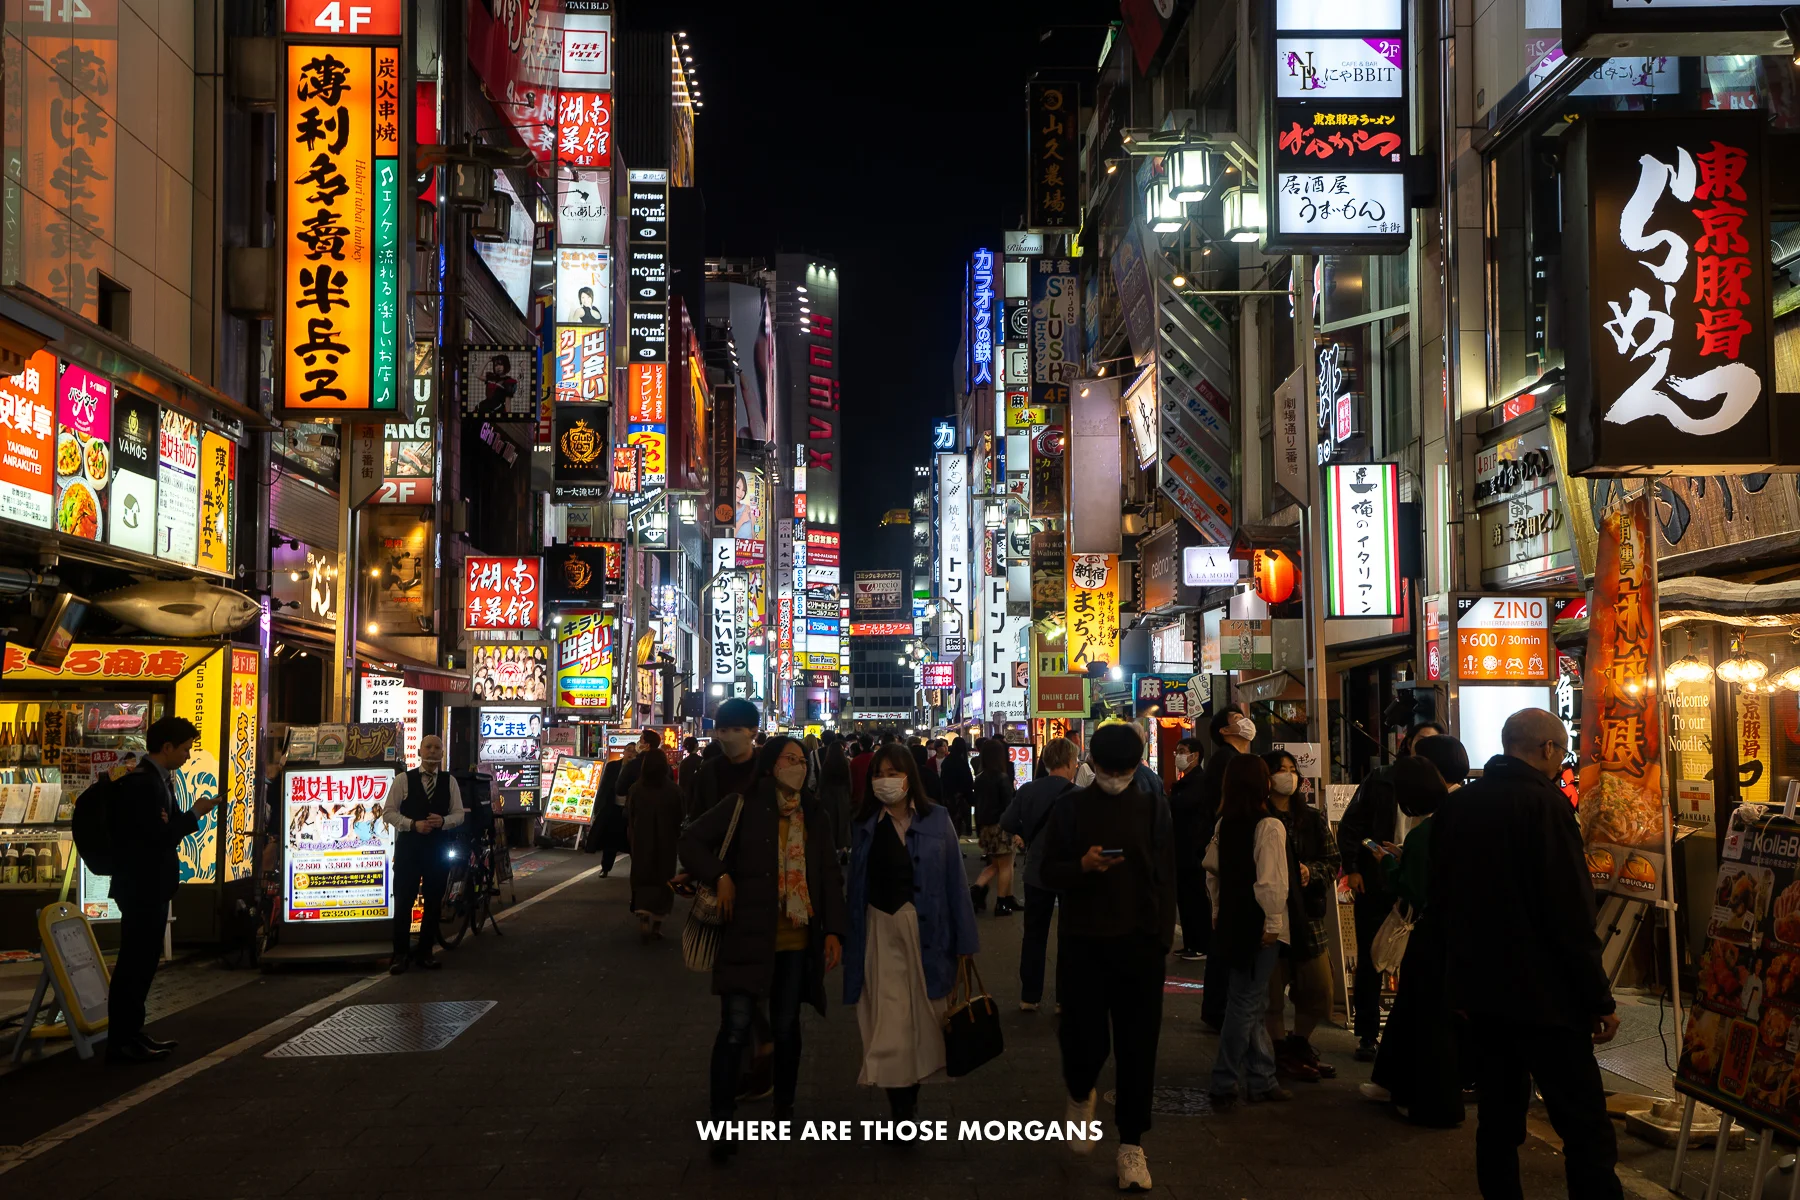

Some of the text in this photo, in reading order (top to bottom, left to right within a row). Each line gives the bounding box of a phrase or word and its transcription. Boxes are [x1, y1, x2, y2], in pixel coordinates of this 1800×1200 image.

[315, 1, 373, 33] 4F
[565, 1, 609, 10] TAKI BLD
[1379, 41, 1400, 57] 2F
[376, 58, 398, 143] 炭火串焼
[559, 95, 610, 126] 湖南
[1313, 112, 1396, 126] 東京豚骨ラーメン
[559, 126, 610, 156] 菜館
[575, 155, 594, 165] 4F
[355, 159, 367, 198] Hakuri
[1281, 175, 1350, 196] 居酒屋
[1367, 222, 1402, 233] 一番街
[1691, 140, 1753, 359] 東京豚骨
[1039, 259, 1071, 274] 麻雀
[634, 312, 663, 320] Party Space
[973, 247, 995, 385] カラオケの鉄人
[560, 330, 576, 380] カフェ
[583, 331, 606, 400] 出会い
[557, 381, 579, 389] キラリ
[641, 365, 653, 422] リフレッシュ
[1044, 388, 1068, 402] 4F
[1032, 425, 1043, 433] 3F
[1283, 397, 1298, 476] 劇場通り一番街
[7, 440, 39, 460] YAKINIKU
[2, 453, 42, 476] ANRAKUTEI
[379, 481, 417, 504] 2F
[1041, 458, 1052, 509] カリーナ
[948, 504, 960, 552] 焼とん酒場
[1351, 498, 1374, 614] 俺のイタリアン
[470, 558, 536, 596] 湖南
[1075, 561, 1106, 581] 新宿
[468, 597, 482, 627] 4F
[482, 596, 536, 628] 菜館
[715, 546, 734, 675] とんかつにいむら
[1458, 599, 1472, 608] 5F
[1494, 601, 1544, 620] ZINO
[1555, 601, 1566, 609] 4F
[563, 612, 605, 636] キラリ
[1073, 591, 1098, 664] まっちゃん
[560, 625, 609, 665] 出会い
[735, 626, 747, 670] ちから
[991, 581, 1006, 694] トントン
[1507, 635, 1541, 646] 30min
[3, 647, 188, 676] まろ商店
[232, 655, 257, 673] 地下1階
[579, 650, 611, 674] カフェ
[924, 665, 952, 675] 24時間
[196, 661, 207, 690] Tuna
[925, 675, 952, 685] 営業中
[1164, 680, 1187, 688] フリー
[1041, 693, 1080, 701] ONLINE CAFE
[1666, 691, 1709, 708] Welcome
[481, 722, 527, 736] りこまき
[1672, 714, 1706, 731] To our
[44, 710, 64, 764] 営業中
[347, 725, 396, 756] オープン
[1668, 735, 1704, 752] Noodle
[1684, 759, 1708, 777] shop
[230, 712, 249, 865] まぐろ商店
[291, 775, 388, 802] 熟女キャバクラ
[1752, 832, 1800, 858] KollaB
[295, 910, 314, 919] 4F
[331, 908, 386, 918] 3205-1005
